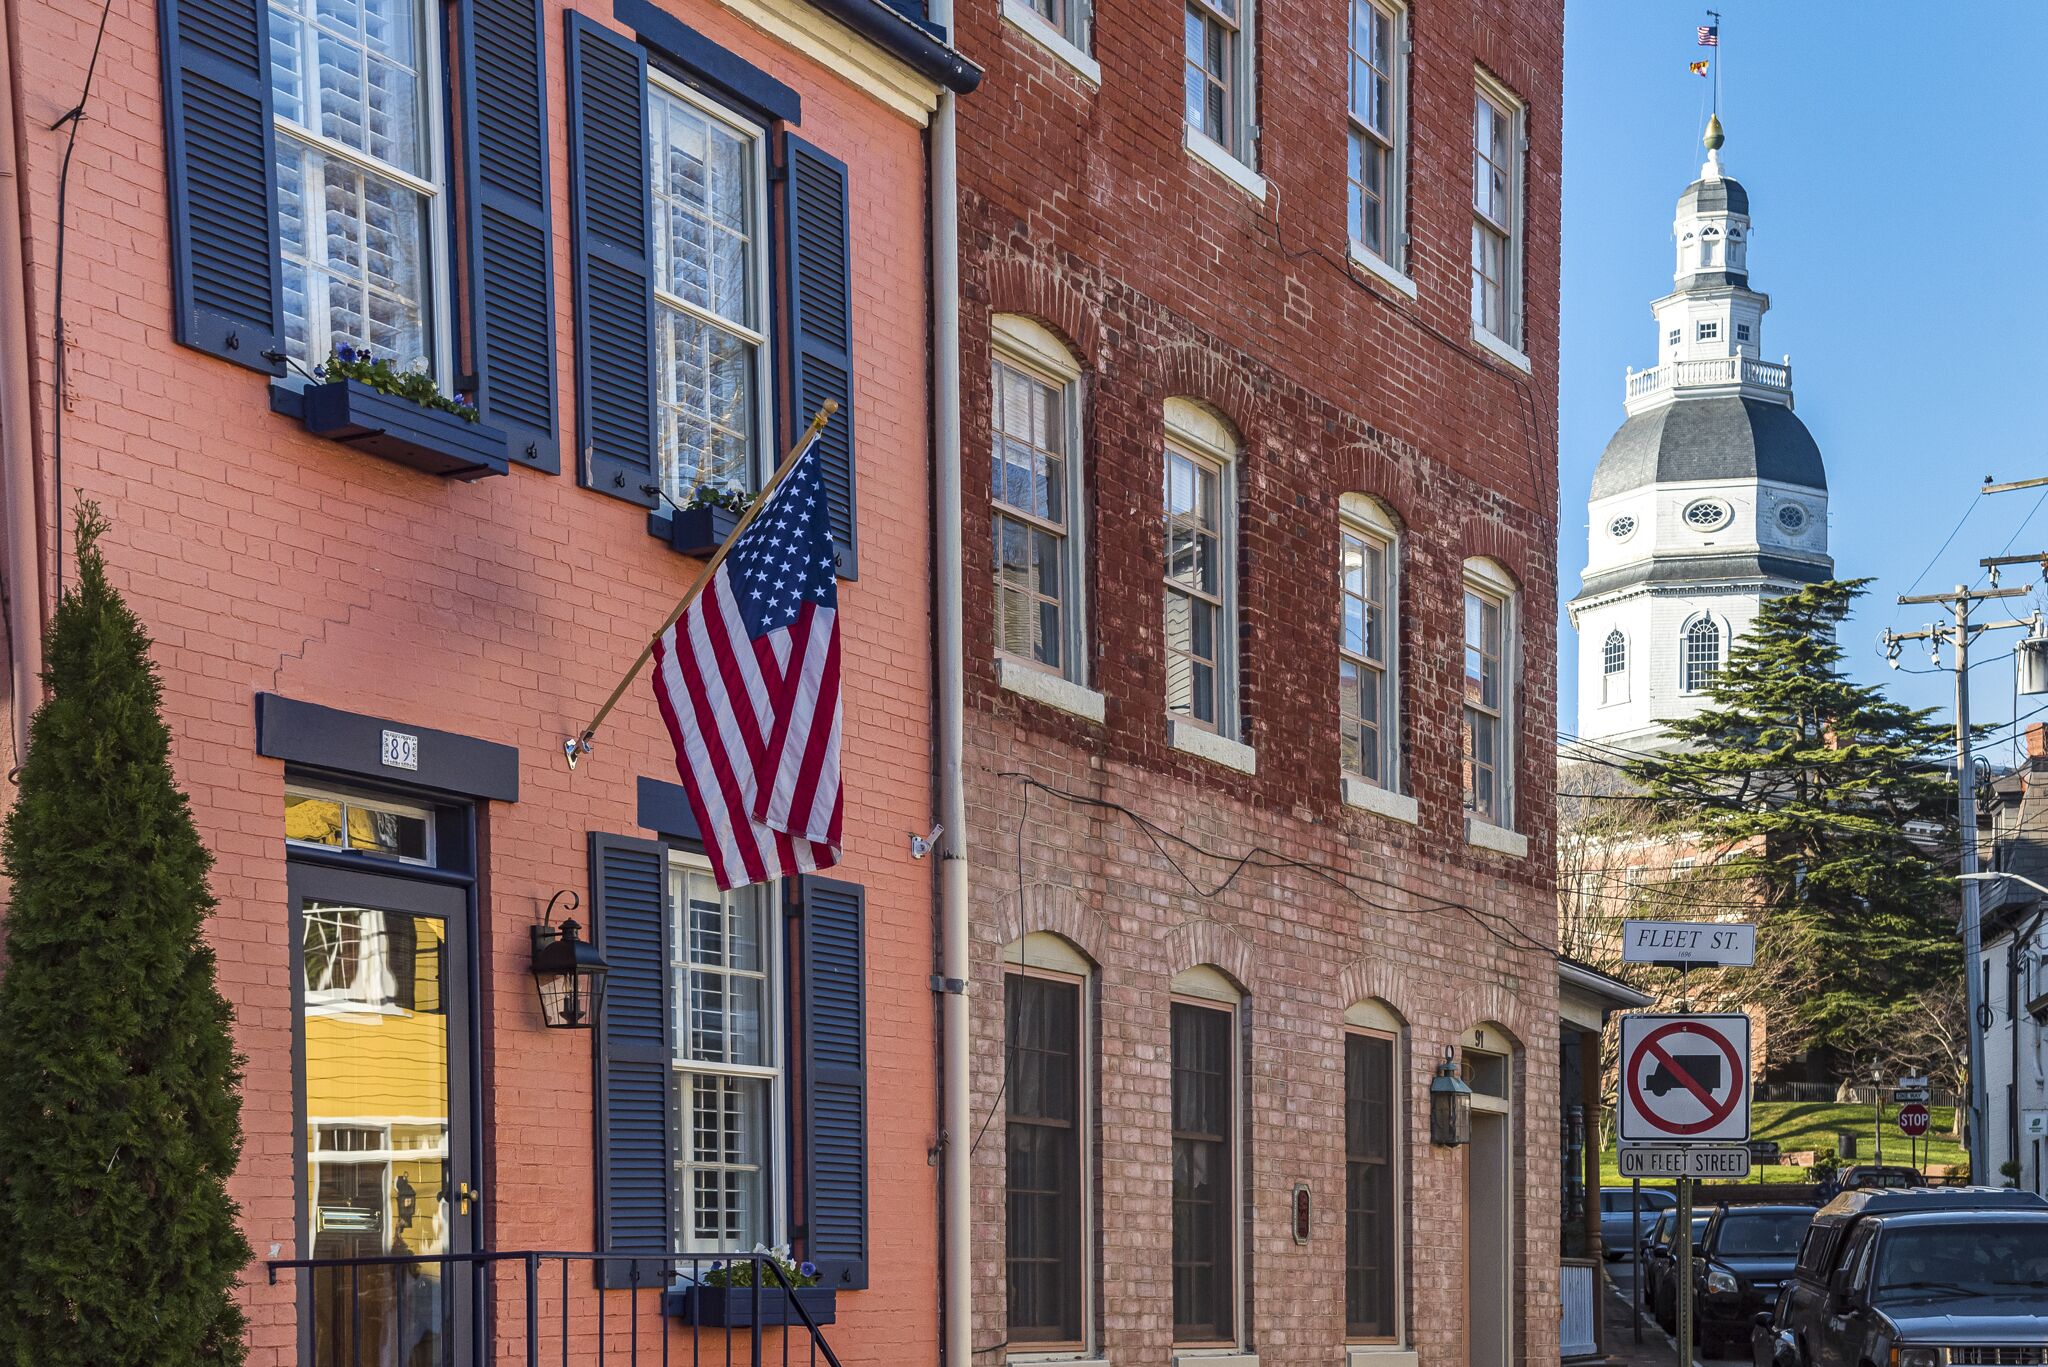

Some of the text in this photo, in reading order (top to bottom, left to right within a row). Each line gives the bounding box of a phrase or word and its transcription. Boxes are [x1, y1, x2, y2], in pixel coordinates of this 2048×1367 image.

[391, 738, 411, 762] 89
[1636, 929, 1739, 950] FLEET ST.
[1475, 1029, 1484, 1049] 91
[1900, 1113, 1929, 1127] STOP
[1626, 1153, 1743, 1172] ON FLEET STREET
